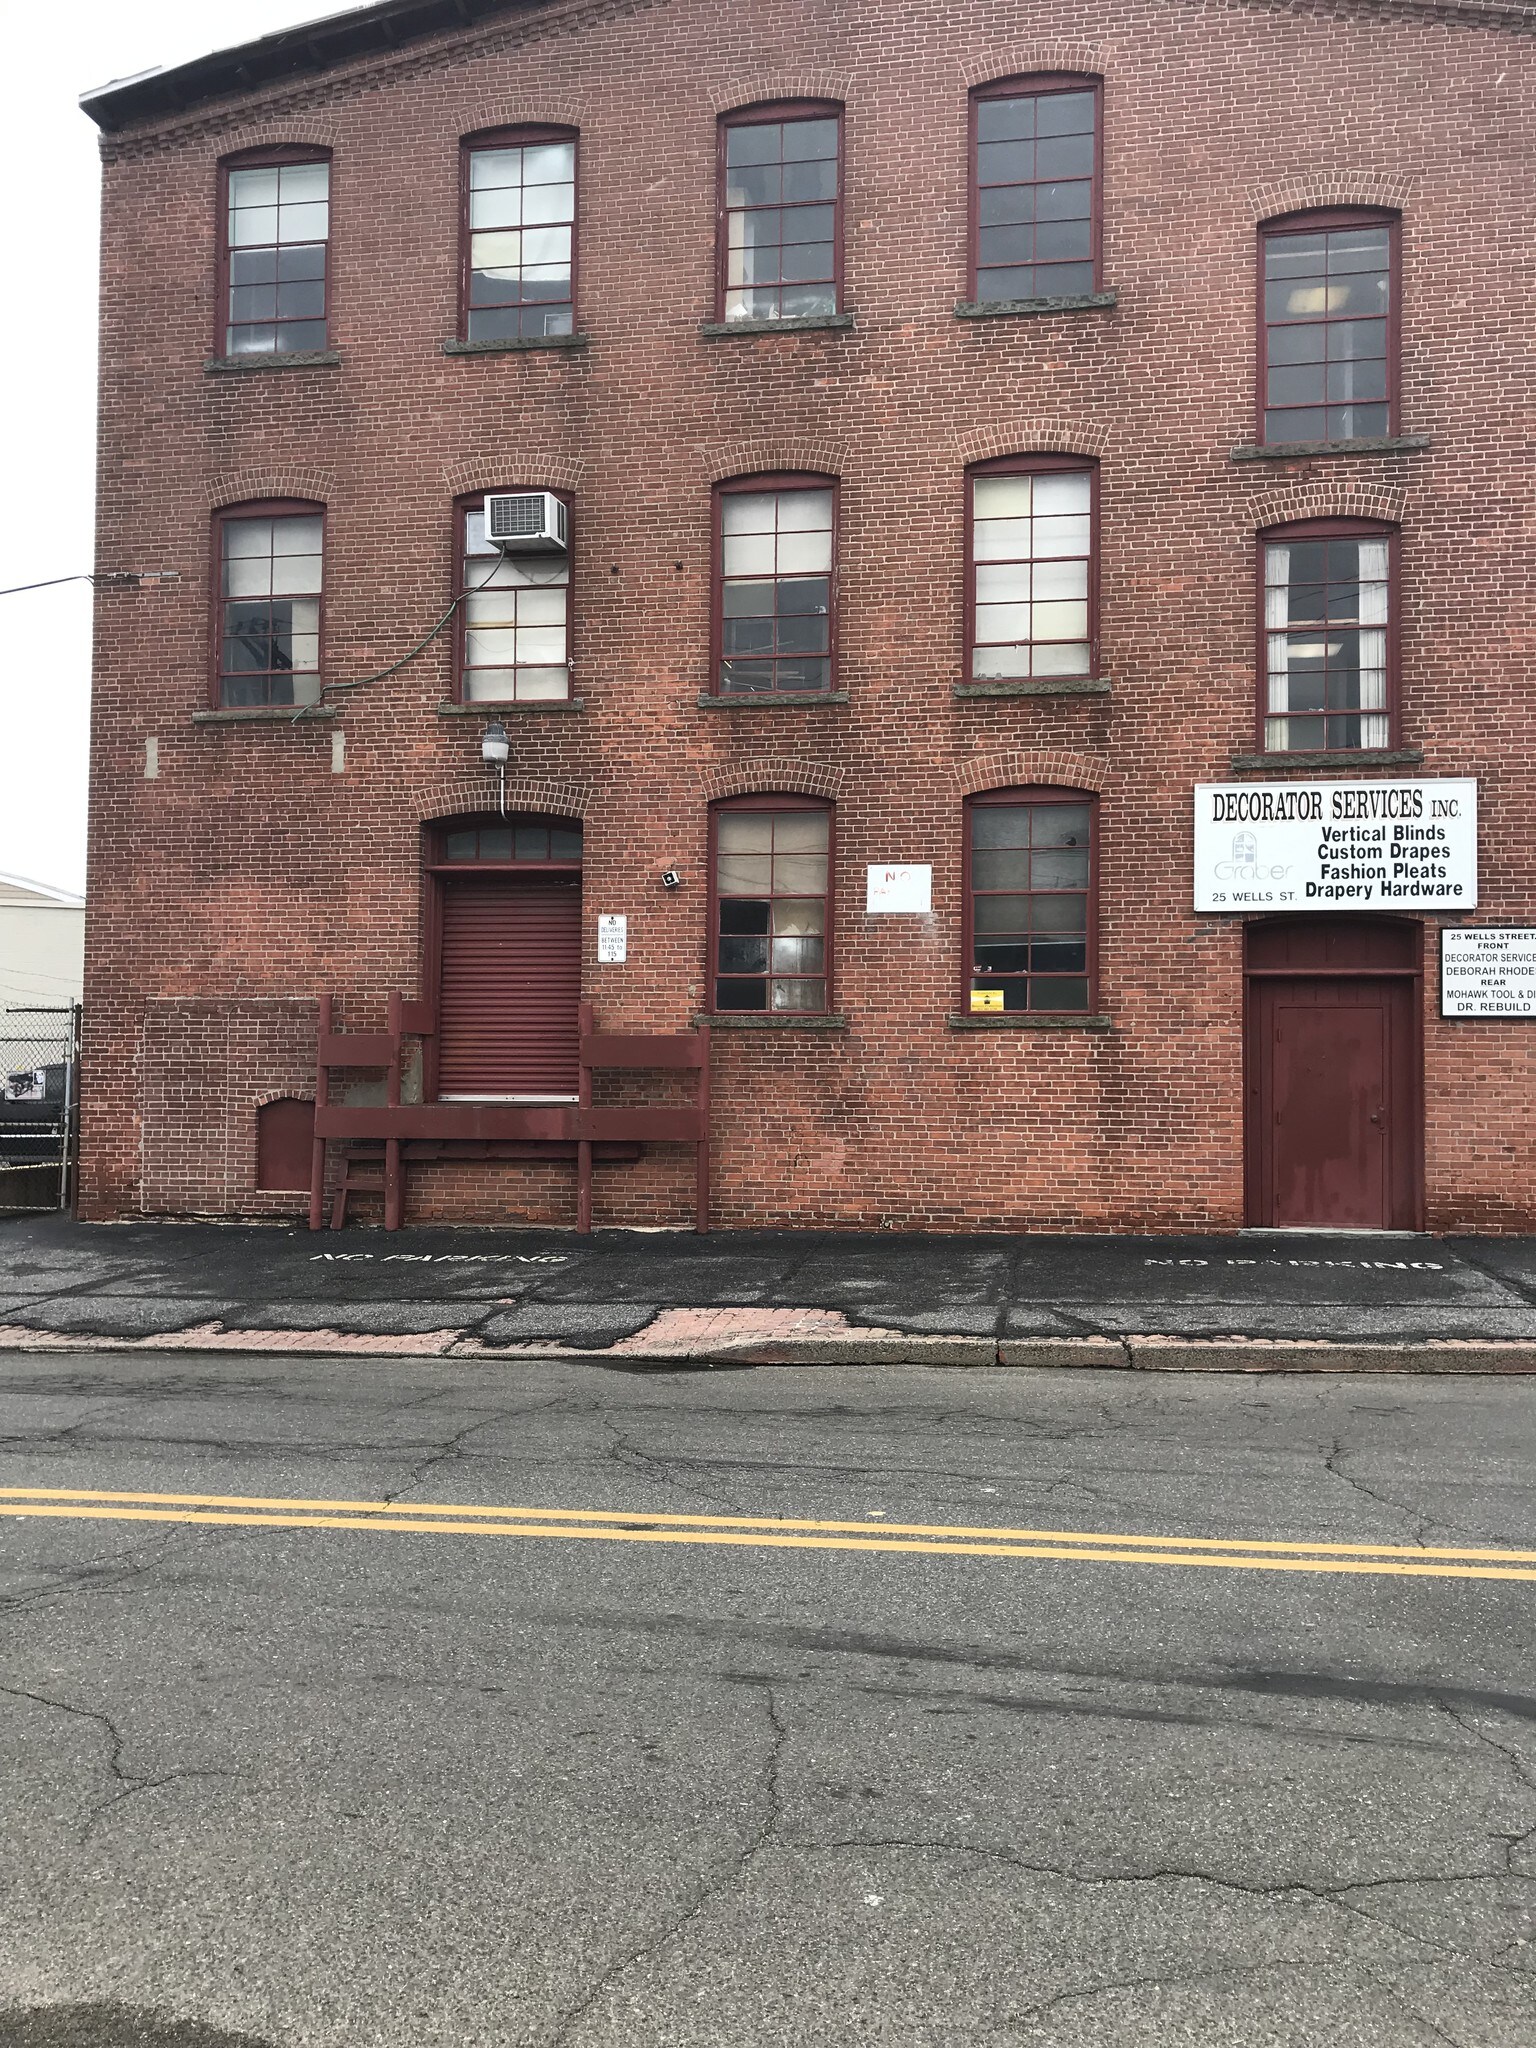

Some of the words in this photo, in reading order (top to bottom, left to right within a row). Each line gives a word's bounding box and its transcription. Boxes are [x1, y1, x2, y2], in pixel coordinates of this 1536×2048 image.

[1212, 790, 1323, 822] DECORATOR
[1332, 789, 1423, 820] SERVICES
[1431, 799, 1462, 818] INC.
[1321, 826, 1386, 842] Vertical
[1393, 825, 1446, 841] Blinds
[1317, 844, 1383, 860] Custom
[1390, 843, 1451, 862] Drapes
[1214, 860, 1294, 881] Graber
[1320, 863, 1386, 880] Fashion
[1393, 862, 1447, 879] Pleats
[1212, 892, 1227, 902] 25
[1232, 892, 1273, 902] WELLS
[1280, 891, 1298, 902] ST.
[1305, 881, 1373, 900] Drapery
[1380, 880, 1463, 897] Hardware
[1444, 953, 1498, 962] DECORATOR
[1446, 966, 1496, 976] DEBORAH
[1499, 966, 1536, 976] RHODE
[1446, 989, 1489, 999] MOHAWK
[1491, 989, 1515, 999] TOOL
[1518, 989, 1525, 999] &
[1457, 1002, 1477, 1012] DR.
[1480, 1002, 1531, 1012] REBUILD
